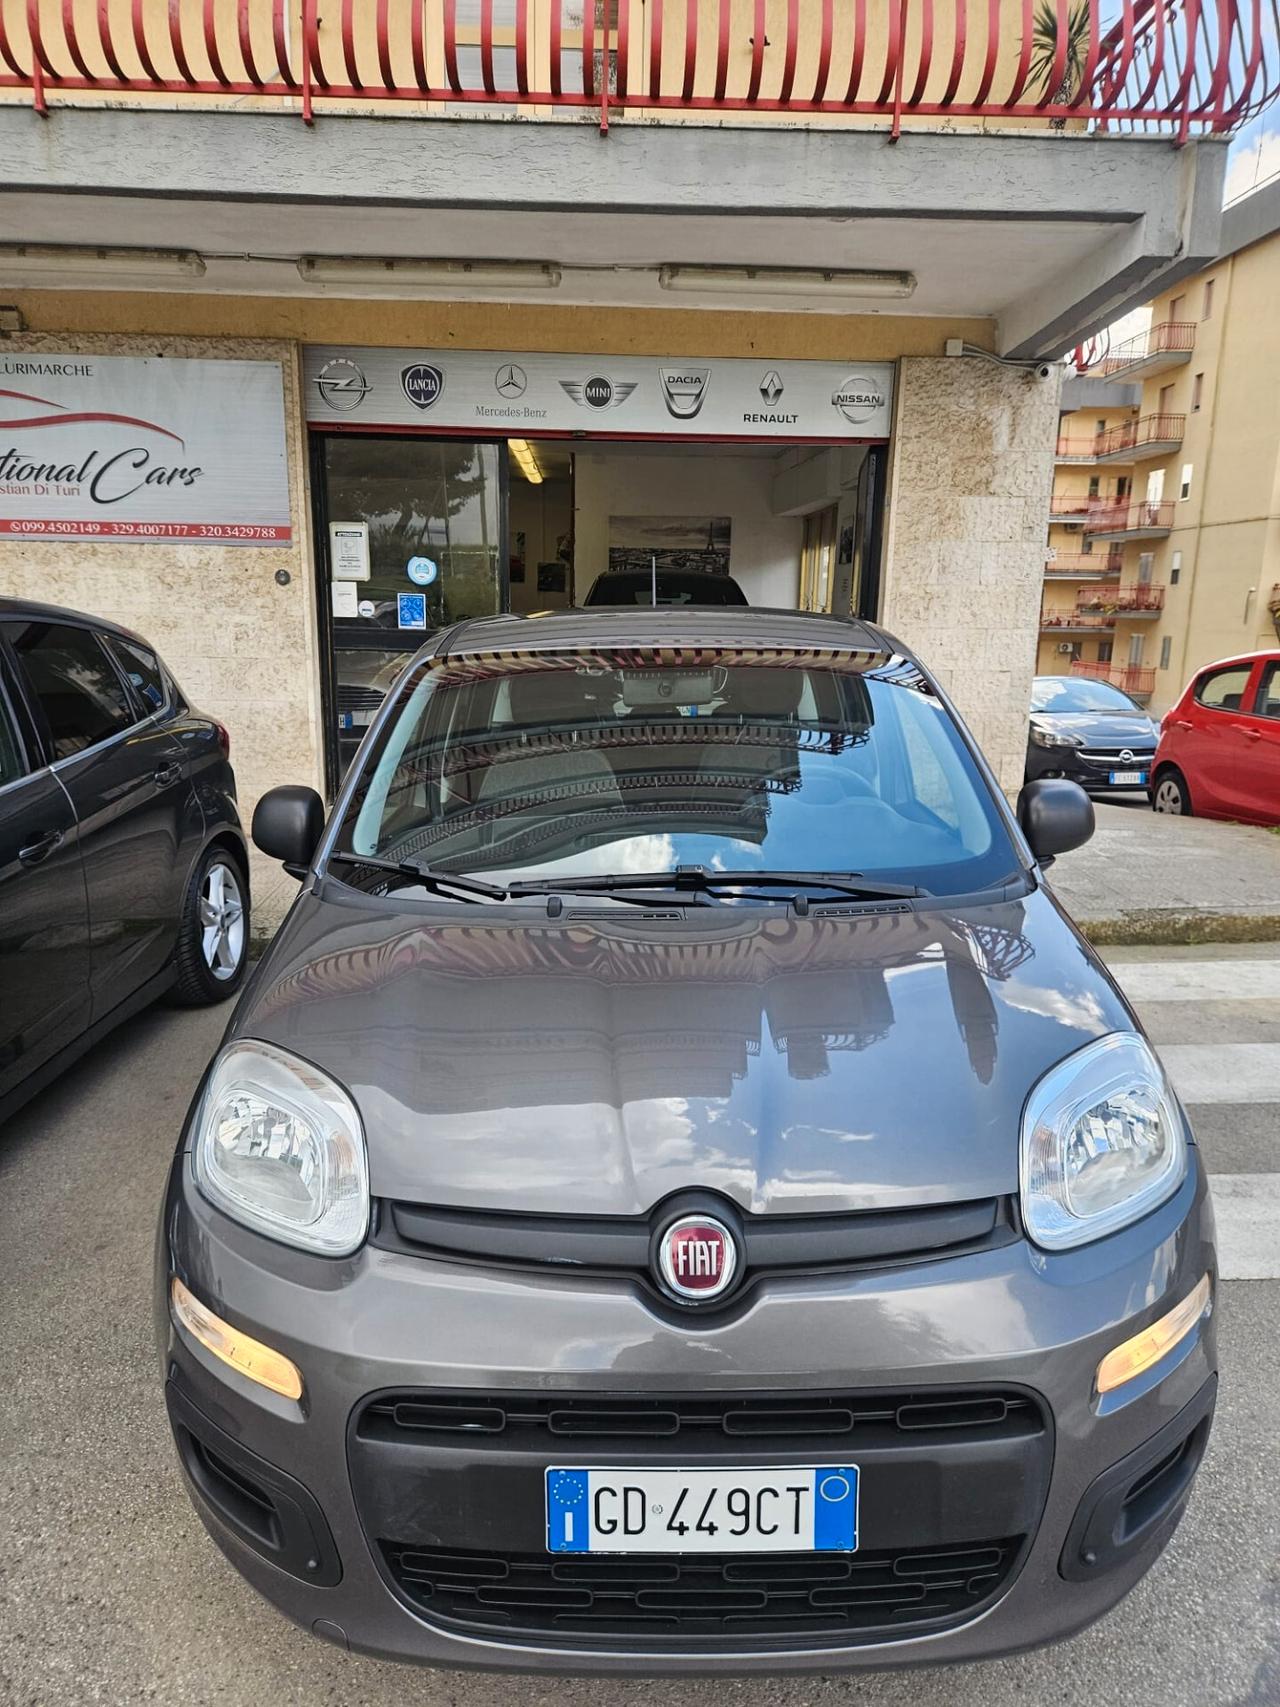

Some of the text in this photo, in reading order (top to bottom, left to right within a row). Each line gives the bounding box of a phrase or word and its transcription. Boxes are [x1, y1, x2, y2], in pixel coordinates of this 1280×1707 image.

[409, 378, 437, 391] LANCIA
[667, 375, 702, 385] DACIA
[586, 387, 611, 398] MINI
[836, 393, 881, 404] NISSAN
[475, 405, 548, 419] Mercedes-Benz
[743, 413, 799, 425] RENAULT
[90, 447, 205, 504] Cars
[34, 482, 50, 496] Di
[53, 484, 81, 497] Turi
[21, 521, 101, 534] 099.4502149
[111, 523, 188, 536] 329.4007177
[199, 526, 276, 538] 320.3429788
[677, 1240, 720, 1276] FIAT
[594, 1486, 647, 1536] GD
[666, 1486, 810, 1537] 449CT
